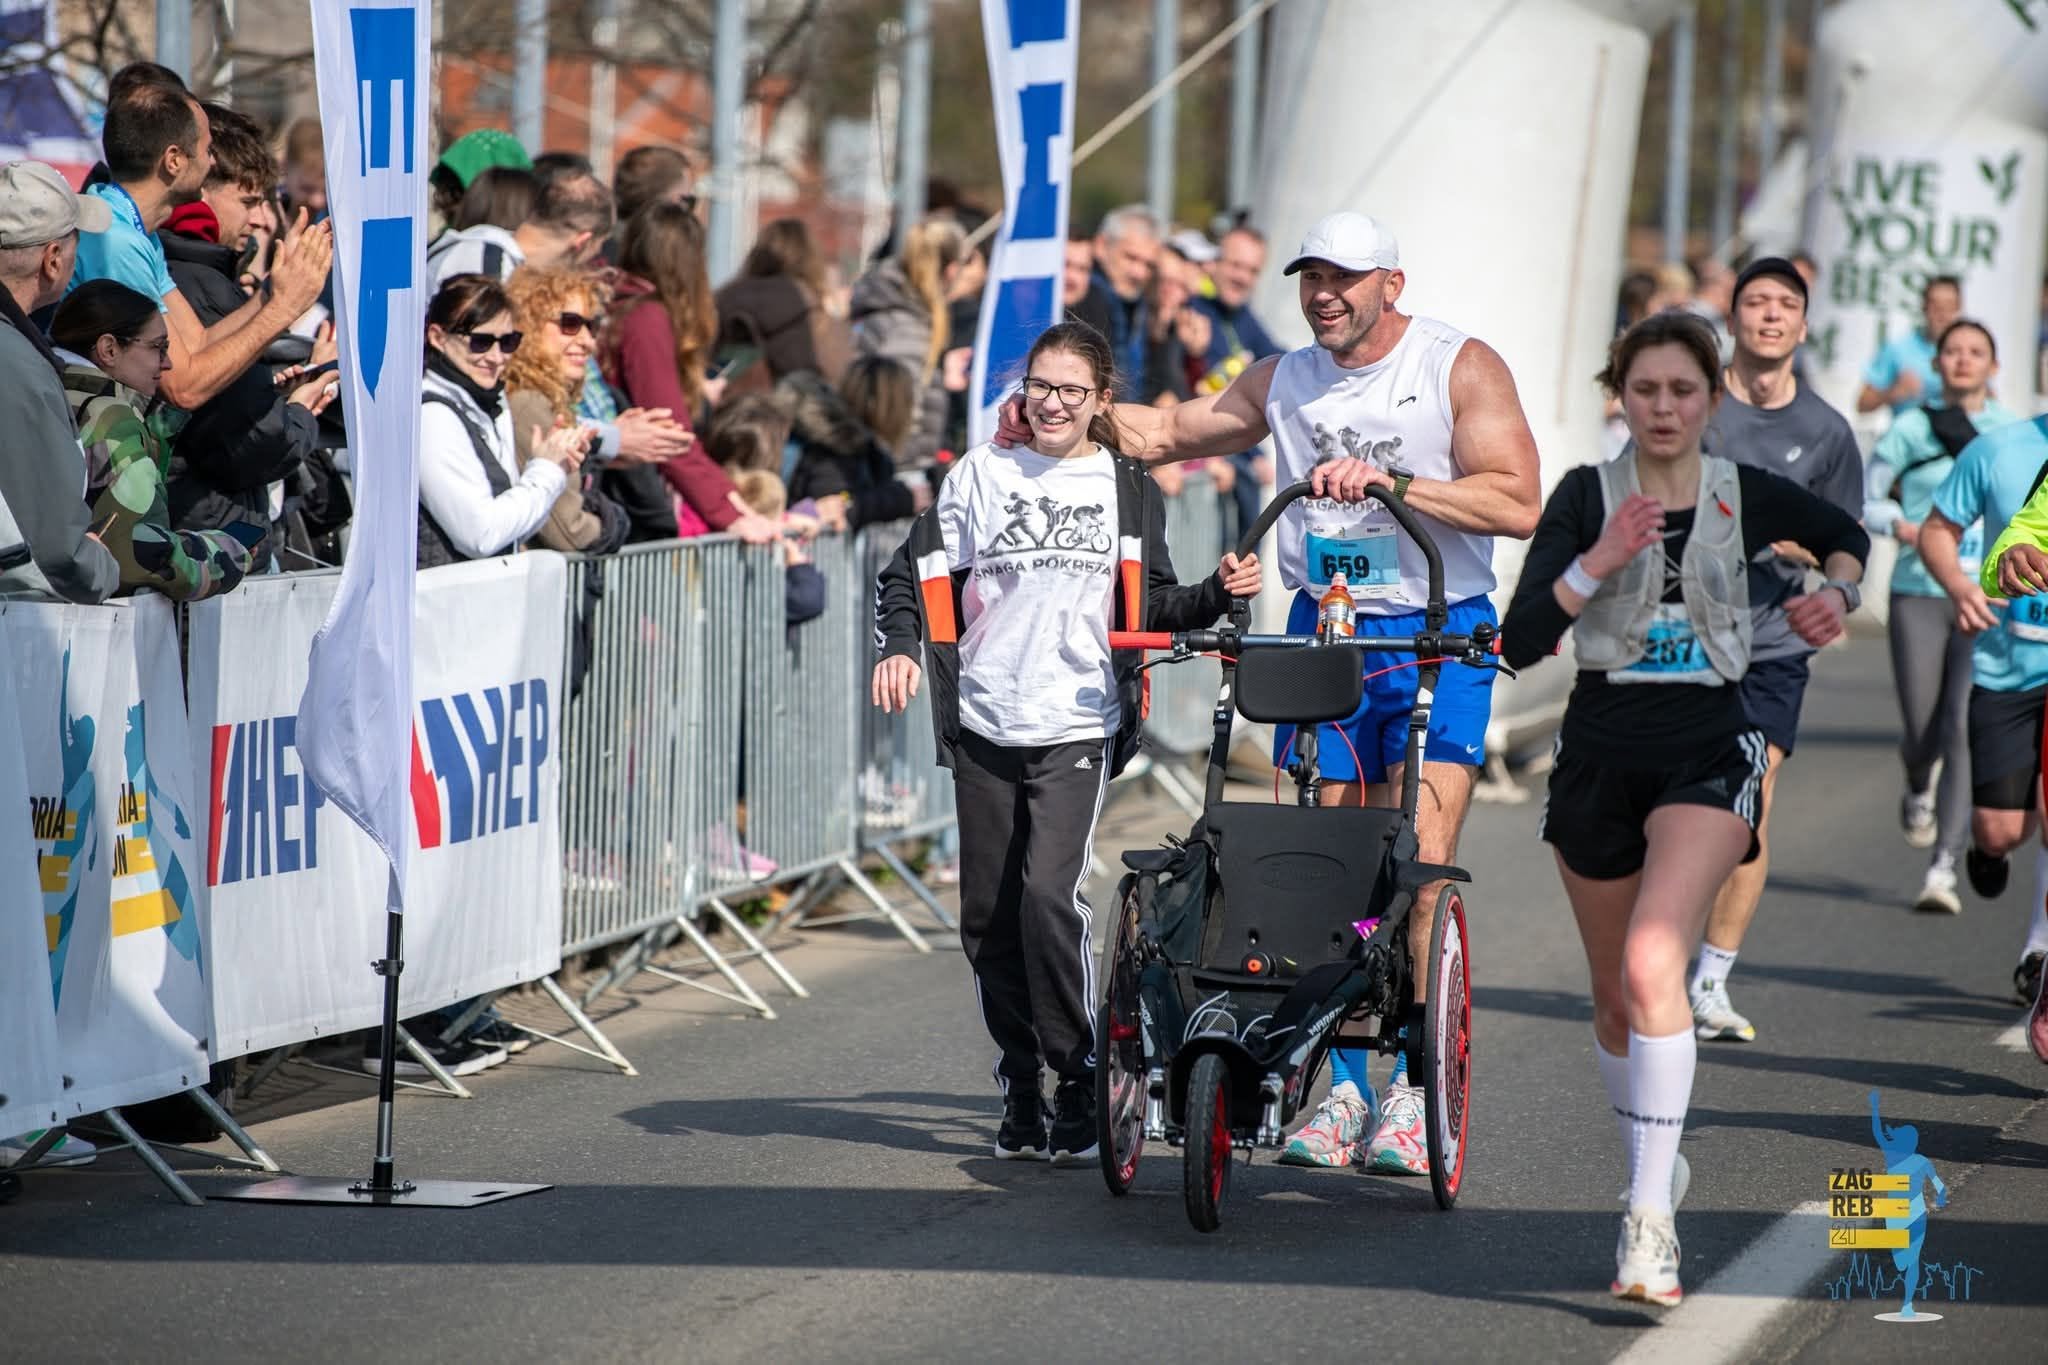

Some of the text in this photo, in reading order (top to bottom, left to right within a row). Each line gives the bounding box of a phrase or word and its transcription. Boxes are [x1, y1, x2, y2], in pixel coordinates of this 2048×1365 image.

[1843, 207, 2000, 266] YOUR
[974, 558, 1112, 581] SNAGA POKRETA
[1322, 553, 1370, 580] 659
[451, 677, 549, 838] HEP
